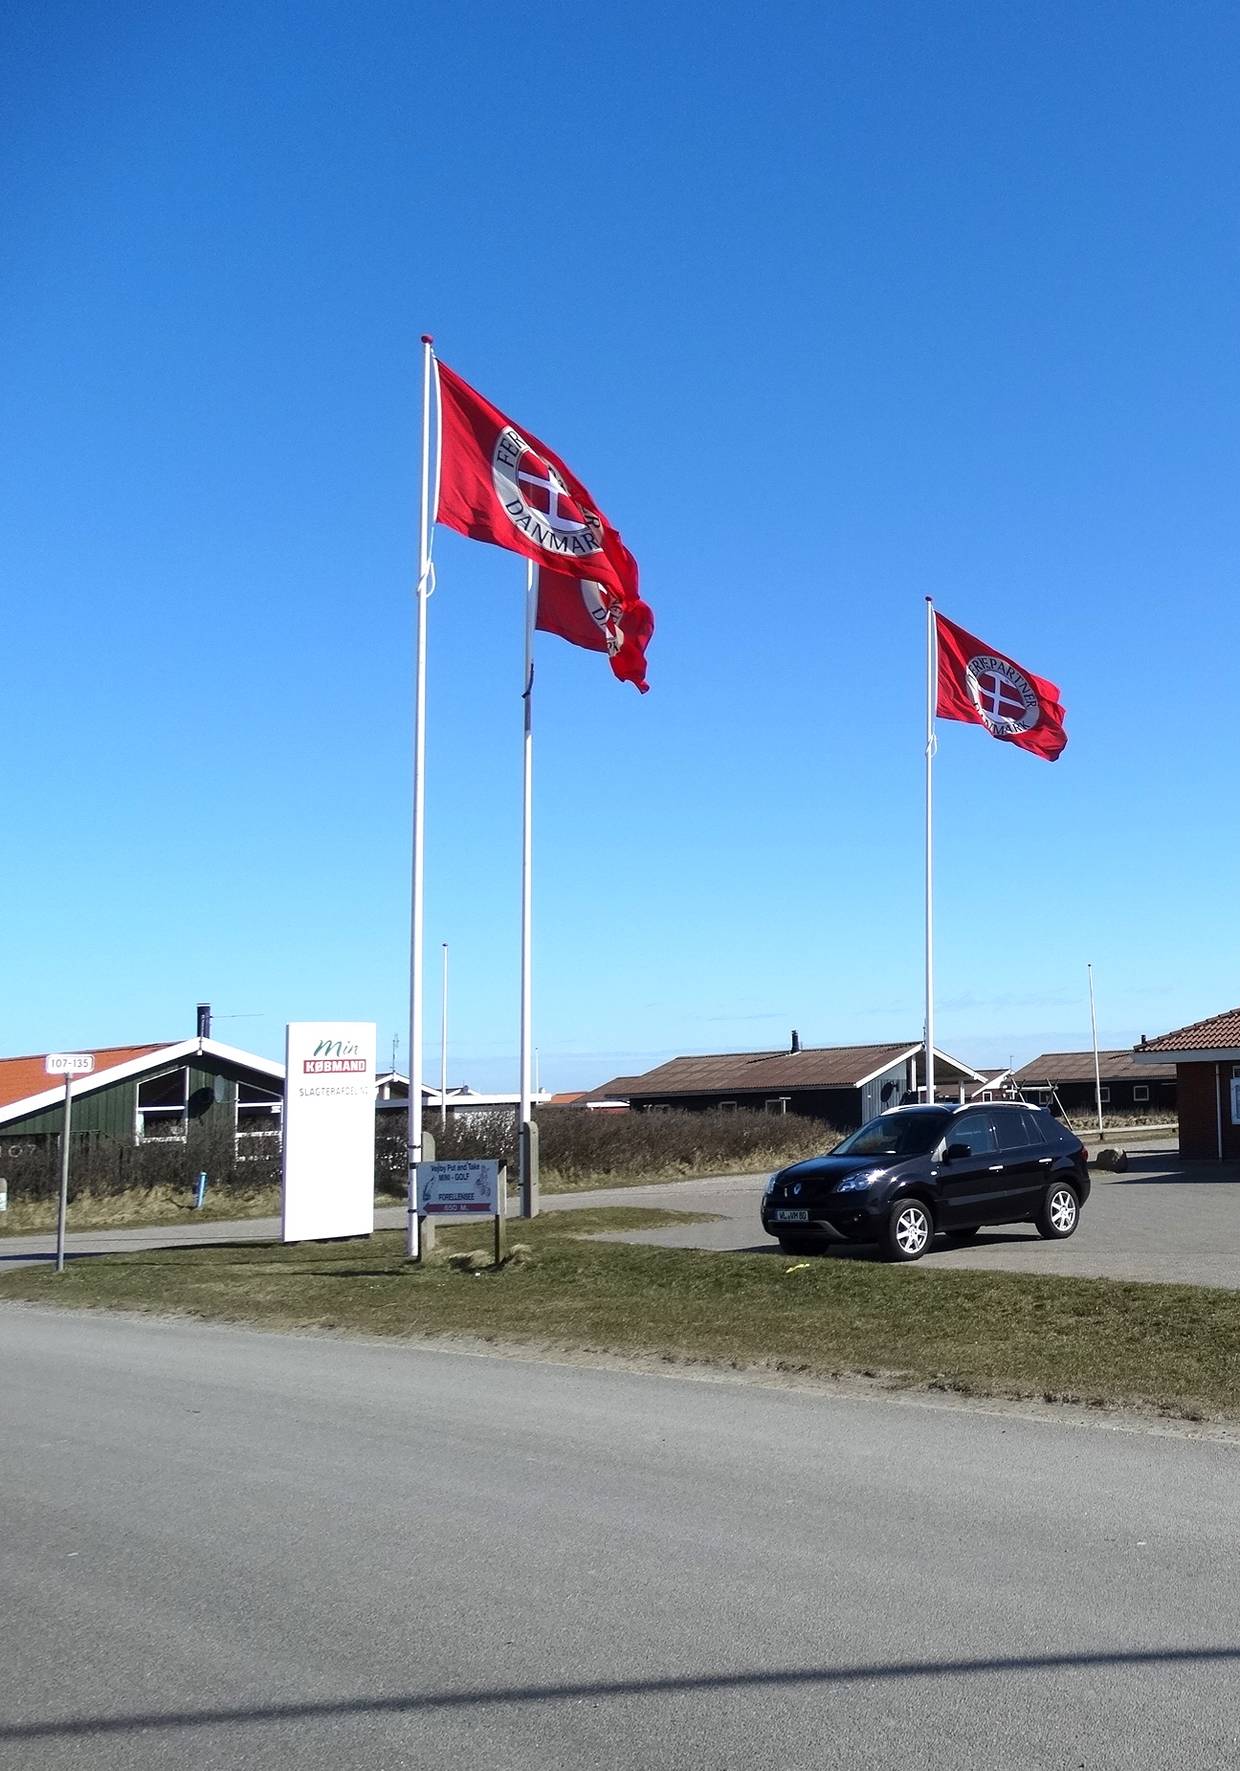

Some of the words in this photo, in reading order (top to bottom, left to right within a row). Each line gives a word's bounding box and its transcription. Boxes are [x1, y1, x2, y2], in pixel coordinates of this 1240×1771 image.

[506, 499, 600, 553] DANMAR
[313, 1040, 359, 1057] Min
[51, 1058, 89, 1069] 107-135
[305, 1060, 366, 1073] KØBMAND
[455, 1172, 470, 1181] GOLF
